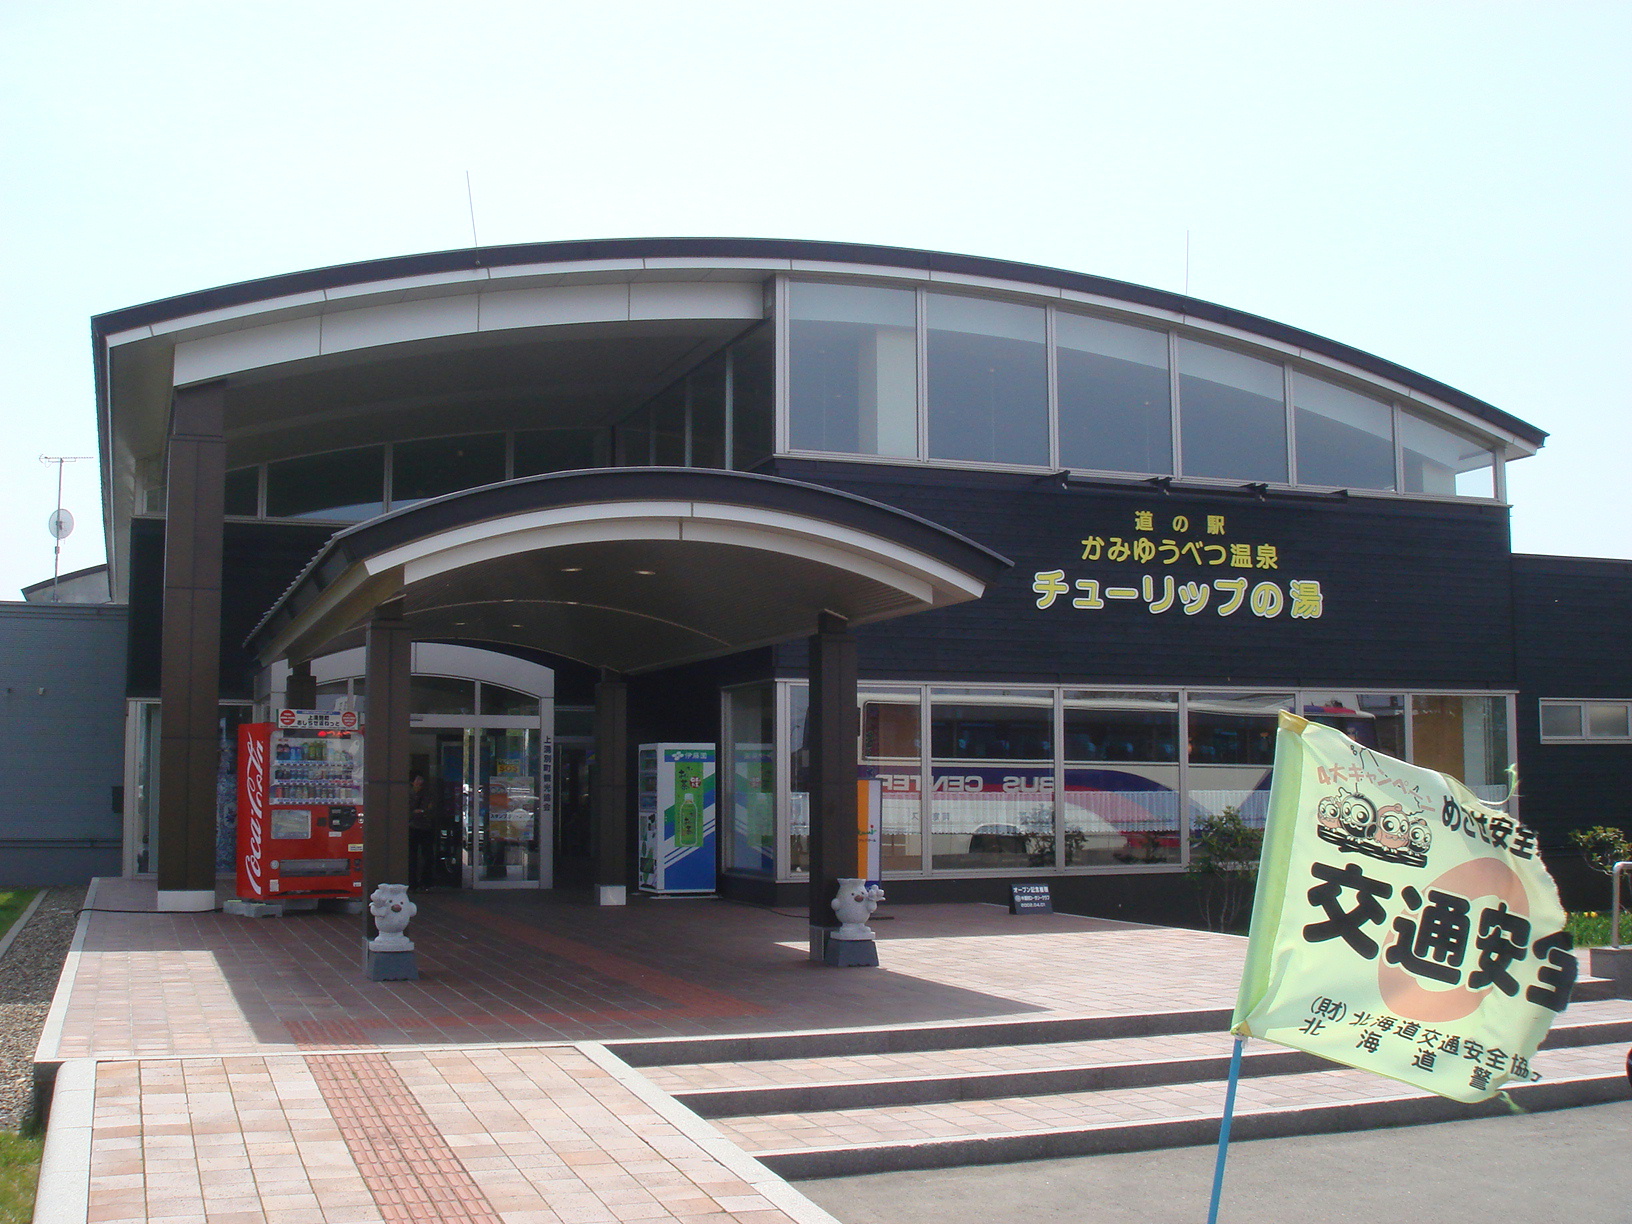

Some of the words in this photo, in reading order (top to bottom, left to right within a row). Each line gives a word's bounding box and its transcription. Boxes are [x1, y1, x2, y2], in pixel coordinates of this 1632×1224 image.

[1134, 510, 1226, 536] 道の駅
[1080, 535, 1279, 570] かみゆうべつ温泉
[1032, 569, 1323, 619] チューリップの湯
[1317, 763, 1436, 813] 4大キャンペーン
[245, 732, 264, 896] Coca-Cola
[1303, 863, 1578, 1013] 交通安全
